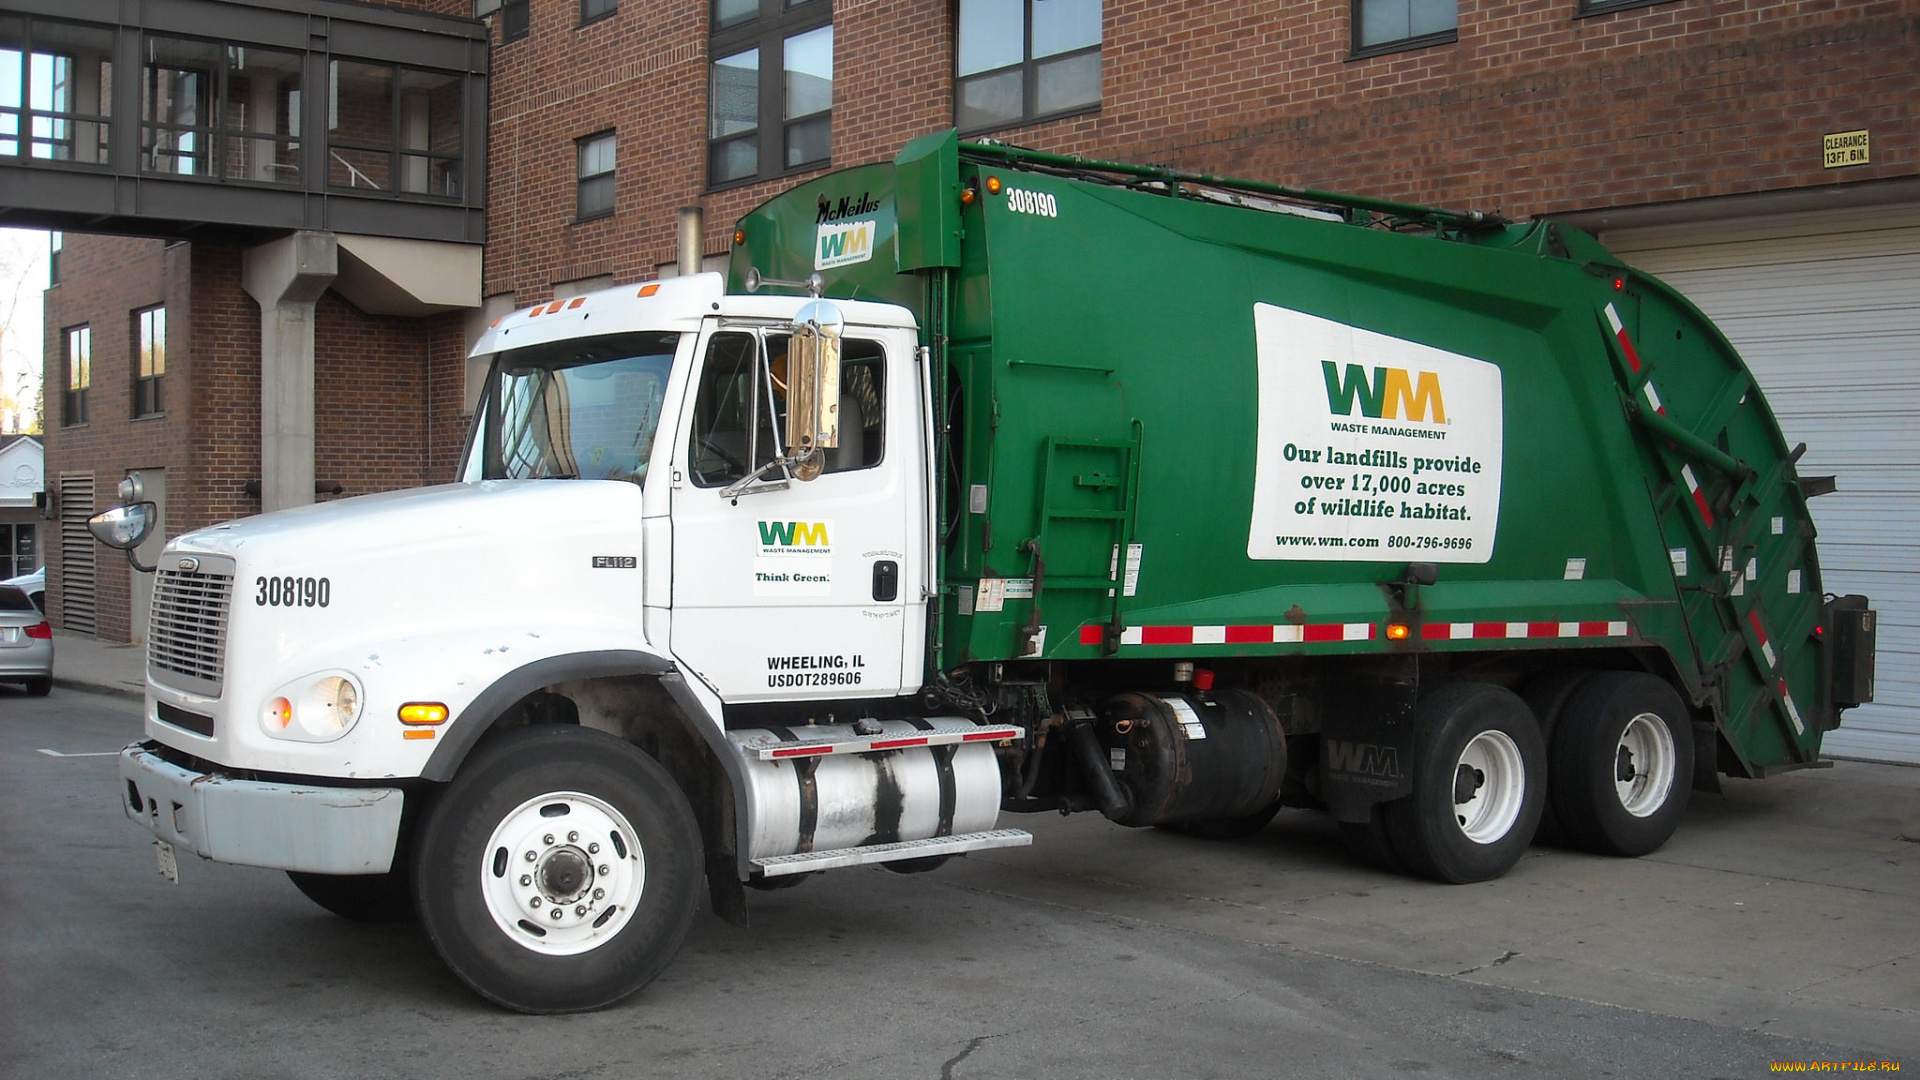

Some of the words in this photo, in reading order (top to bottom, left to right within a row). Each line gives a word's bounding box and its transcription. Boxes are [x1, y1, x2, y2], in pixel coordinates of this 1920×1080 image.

[1825, 134, 1867, 150] CLEARANCE
[1826, 151, 1848, 164] 13FT.
[1850, 149, 1867, 161] 6IN.
[816, 192, 880, 224] McNeilus
[1006, 187, 1057, 217] 308190
[821, 227, 867, 259] WM
[1321, 360, 1446, 424] WM
[1331, 422, 1368, 434] WASTE
[1371, 426, 1446, 440] MANAGEMENT
[1283, 443, 1321, 463] Our
[1327, 446, 1407, 469] landfills
[1413, 456, 1481, 475] provide
[1301, 475, 1345, 490] over
[1352, 473, 1411, 496] 17,000
[1417, 482, 1465, 497] acres
[1294, 497, 1316, 514] of
[1321, 498, 1395, 518] wildlife
[1400, 501, 1472, 521] habitat.
[758, 521, 829, 546] WM
[1276, 535, 1379, 548] www.wm.com
[1387, 535, 1472, 549] 800-796-9696
[596, 557, 633, 567] FL112
[755, 573, 790, 582] Think
[793, 573, 830, 582] Green.
[256, 576, 330, 607] 308190
[767, 655, 848, 670] WHEELING,
[853, 655, 865, 668] IL
[768, 672, 862, 688] USDOT289606
[1327, 740, 1399, 778] WM
